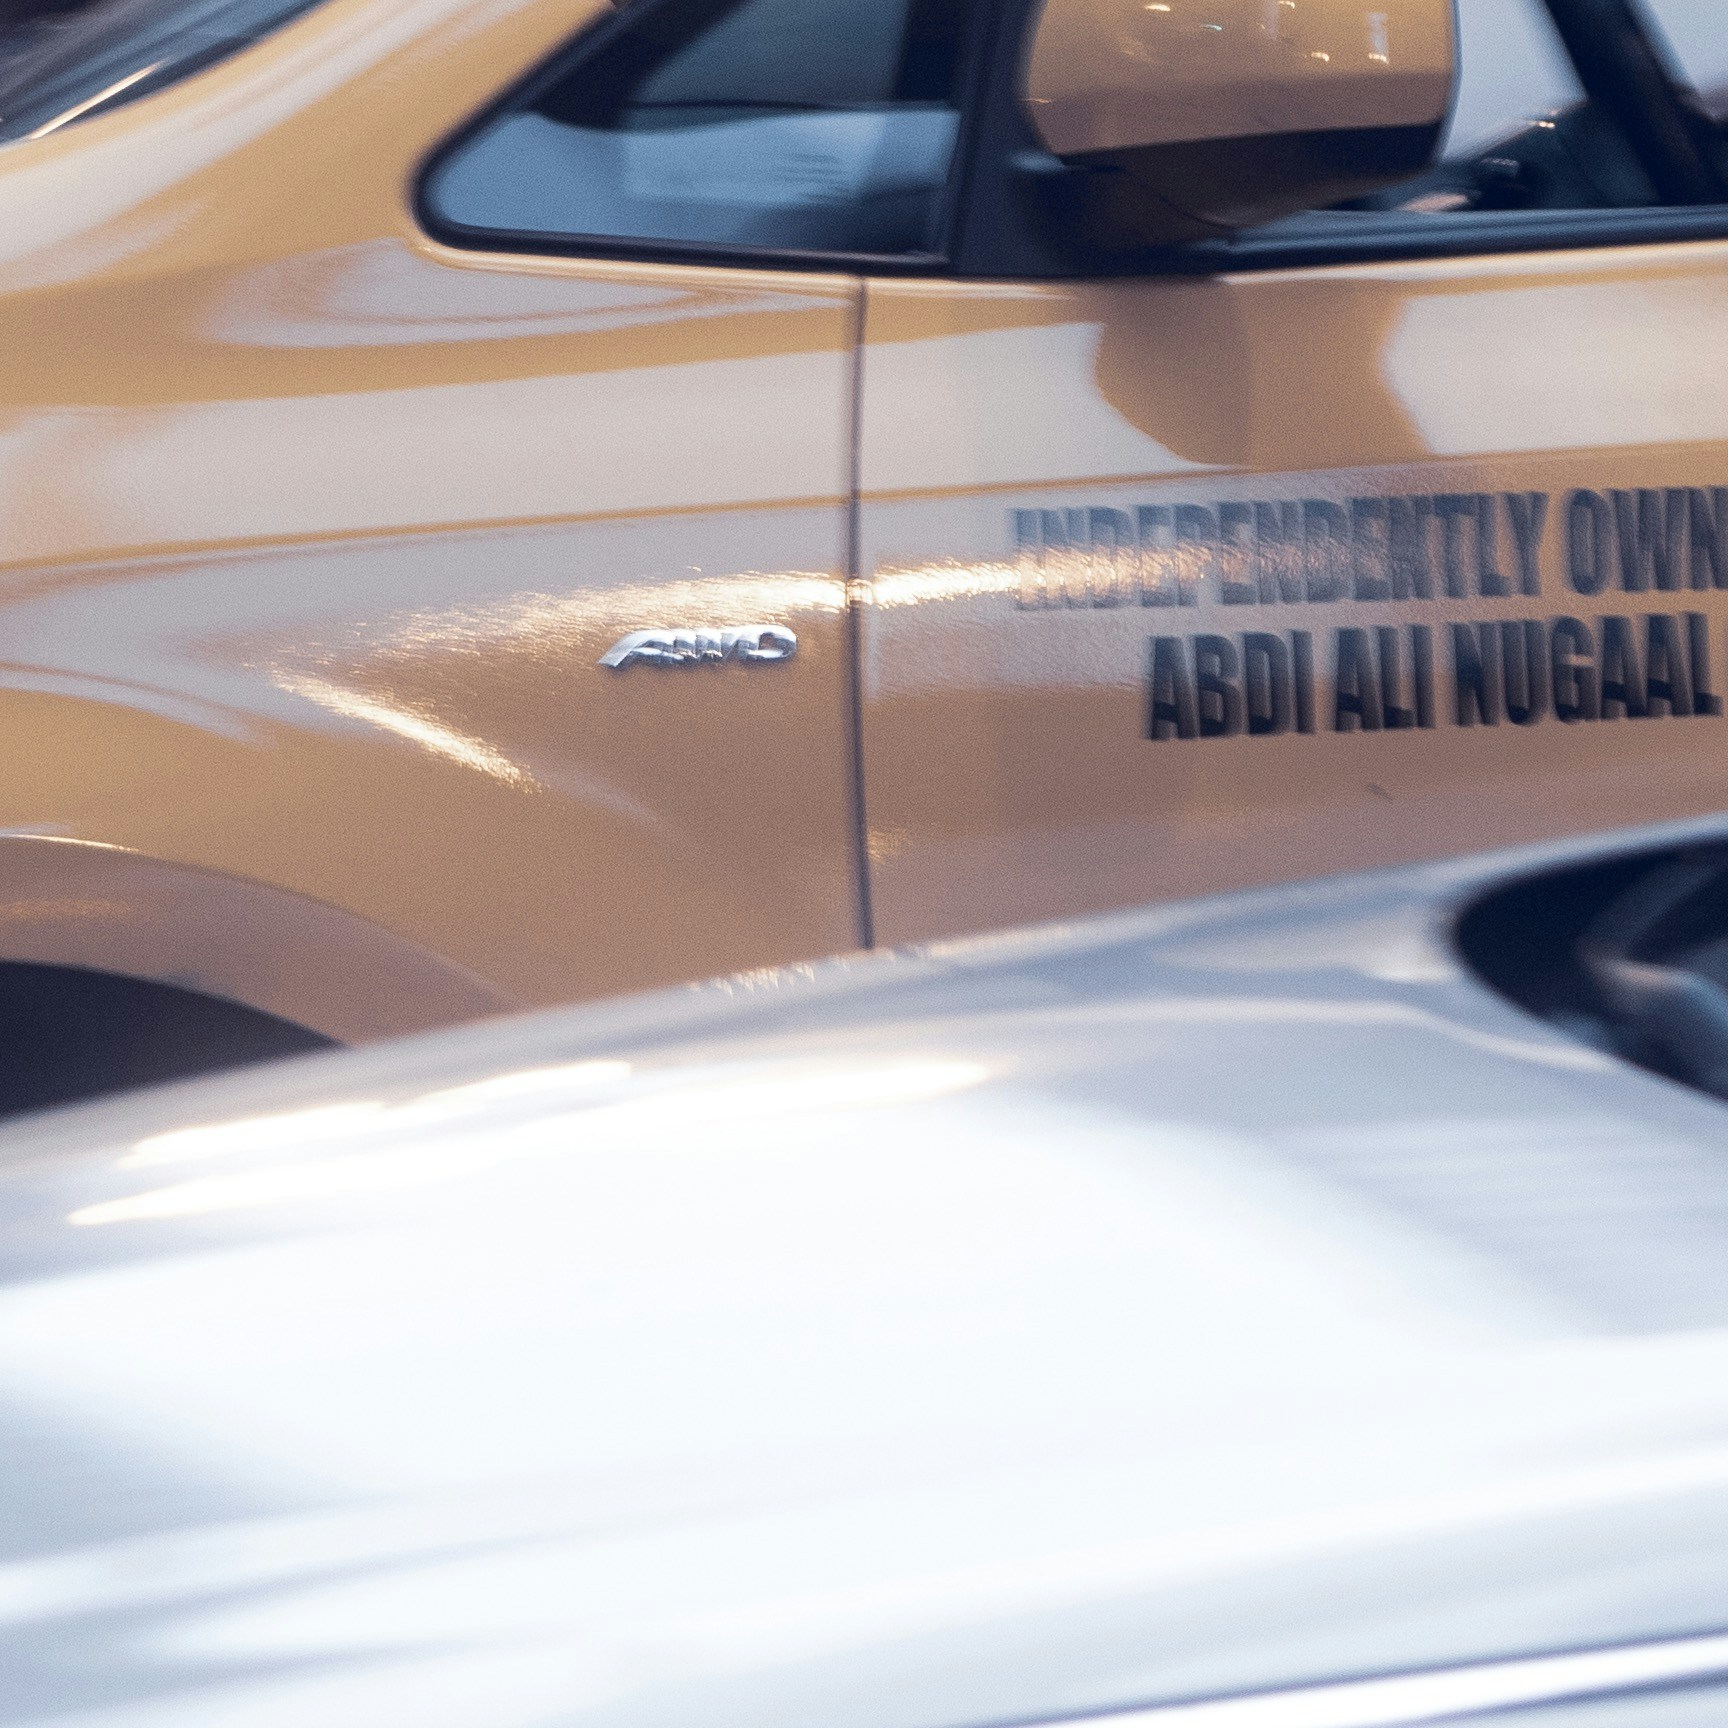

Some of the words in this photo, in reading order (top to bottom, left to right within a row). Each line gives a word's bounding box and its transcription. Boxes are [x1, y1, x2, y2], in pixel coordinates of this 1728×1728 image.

[1010, 491, 1549, 610] INDEPENDENTLY
[1145, 628, 1314, 741] ABDI
[1332, 623, 1436, 732] ALI
[1450, 611, 1725, 727] NUGAAL
